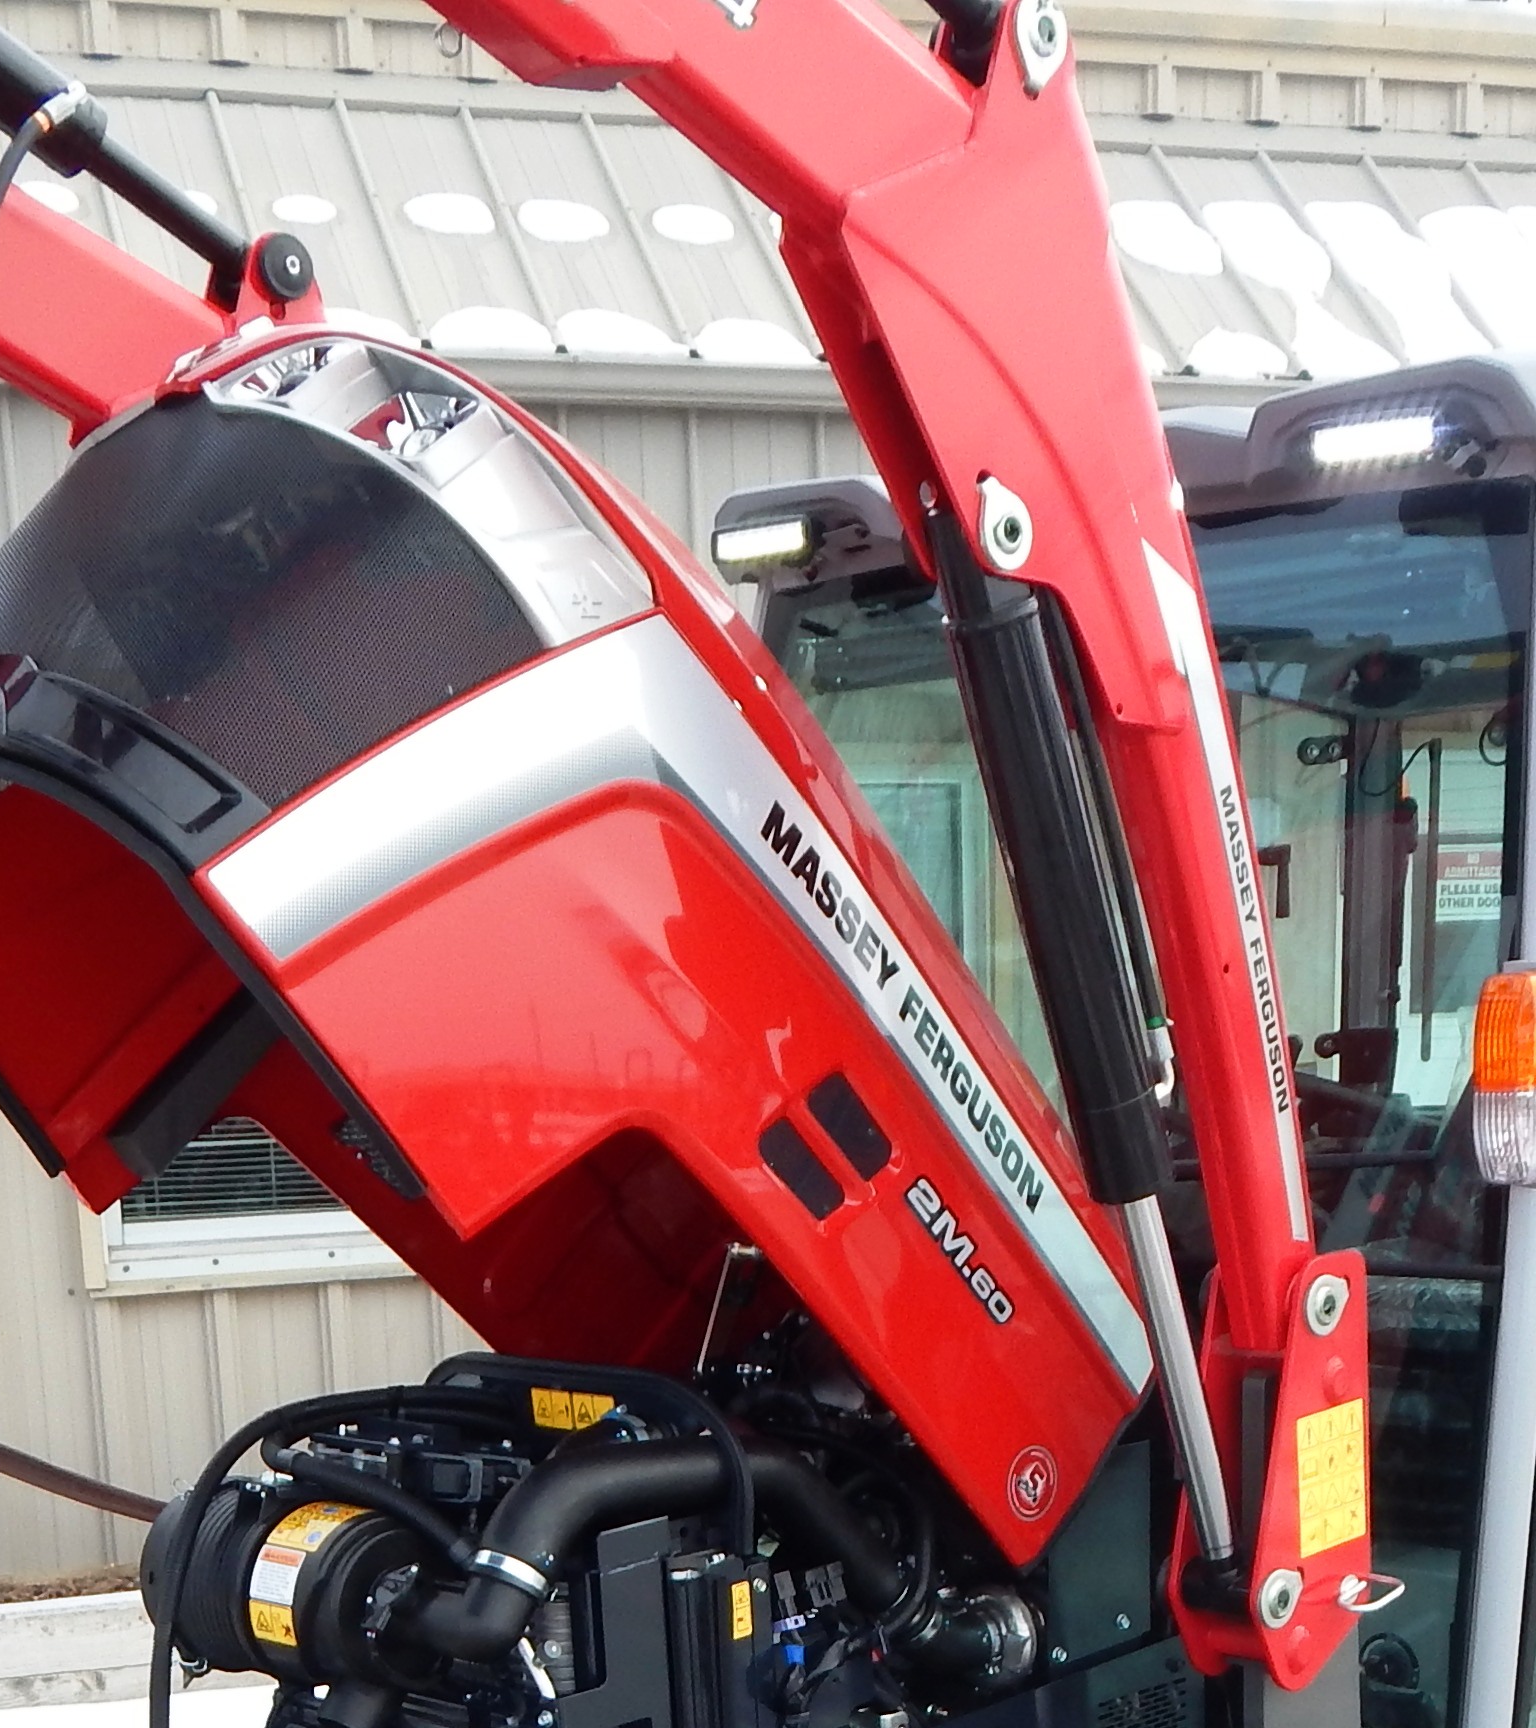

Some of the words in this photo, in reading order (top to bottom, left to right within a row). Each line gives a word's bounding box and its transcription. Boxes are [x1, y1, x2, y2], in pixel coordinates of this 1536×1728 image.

[1219, 785, 1257, 922] MASSEY
[1249, 937, 1289, 1113] FERGUSON
[1438, 897, 1474, 909] OTHER
[1477, 896, 1500, 908] DOO
[1440, 884, 1481, 896] PLEASE
[1484, 883, 1499, 894] US
[760, 803, 900, 990] MASSEY
[899, 985, 1045, 1214] FERGUSON
[905, 1176, 1014, 1324] 2M.60
